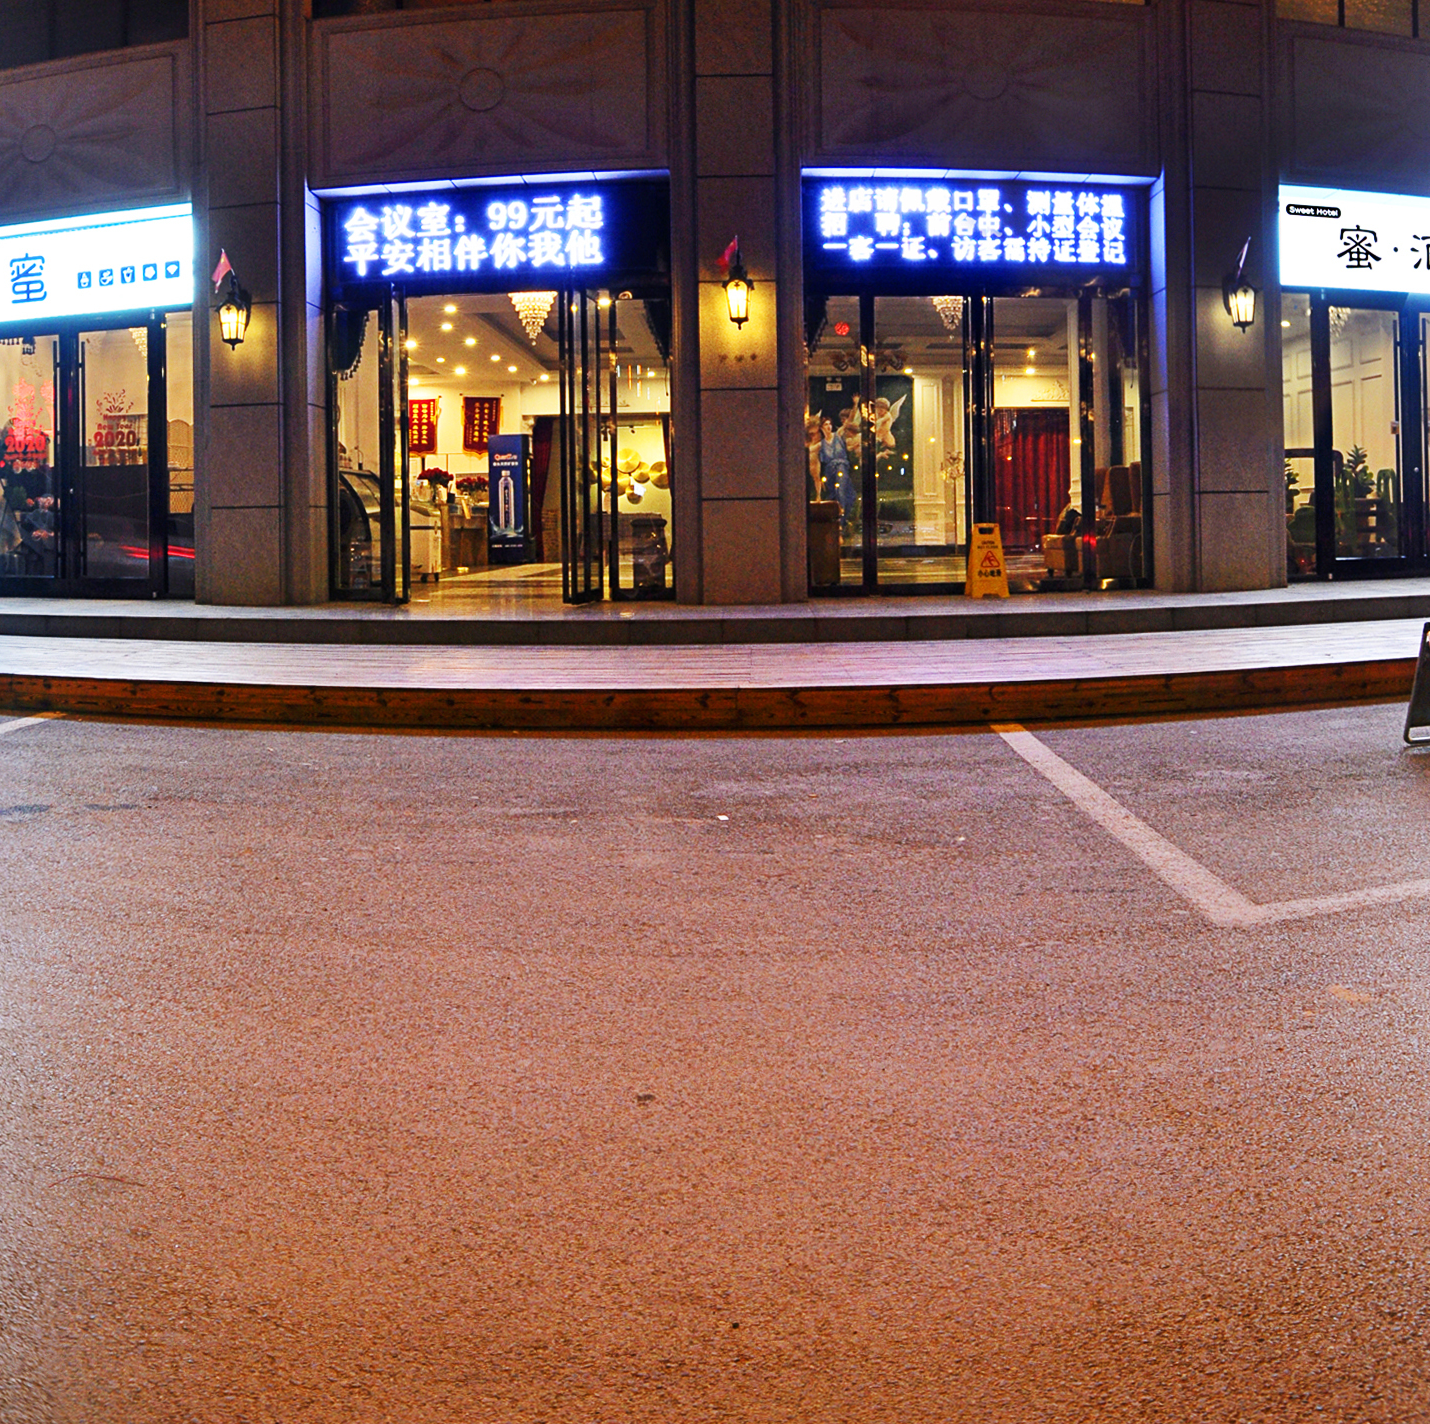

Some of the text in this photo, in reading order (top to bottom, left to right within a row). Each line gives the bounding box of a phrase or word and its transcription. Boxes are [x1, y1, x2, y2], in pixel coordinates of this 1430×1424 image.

[1289, 205, 1339, 217] Sweet Hotel
[821, 212, 848, 236] 招
[343, 228, 605, 277] 平安相伴你我他
[4, 435, 46, 453] 2020
[93, 430, 136, 447] 2020
